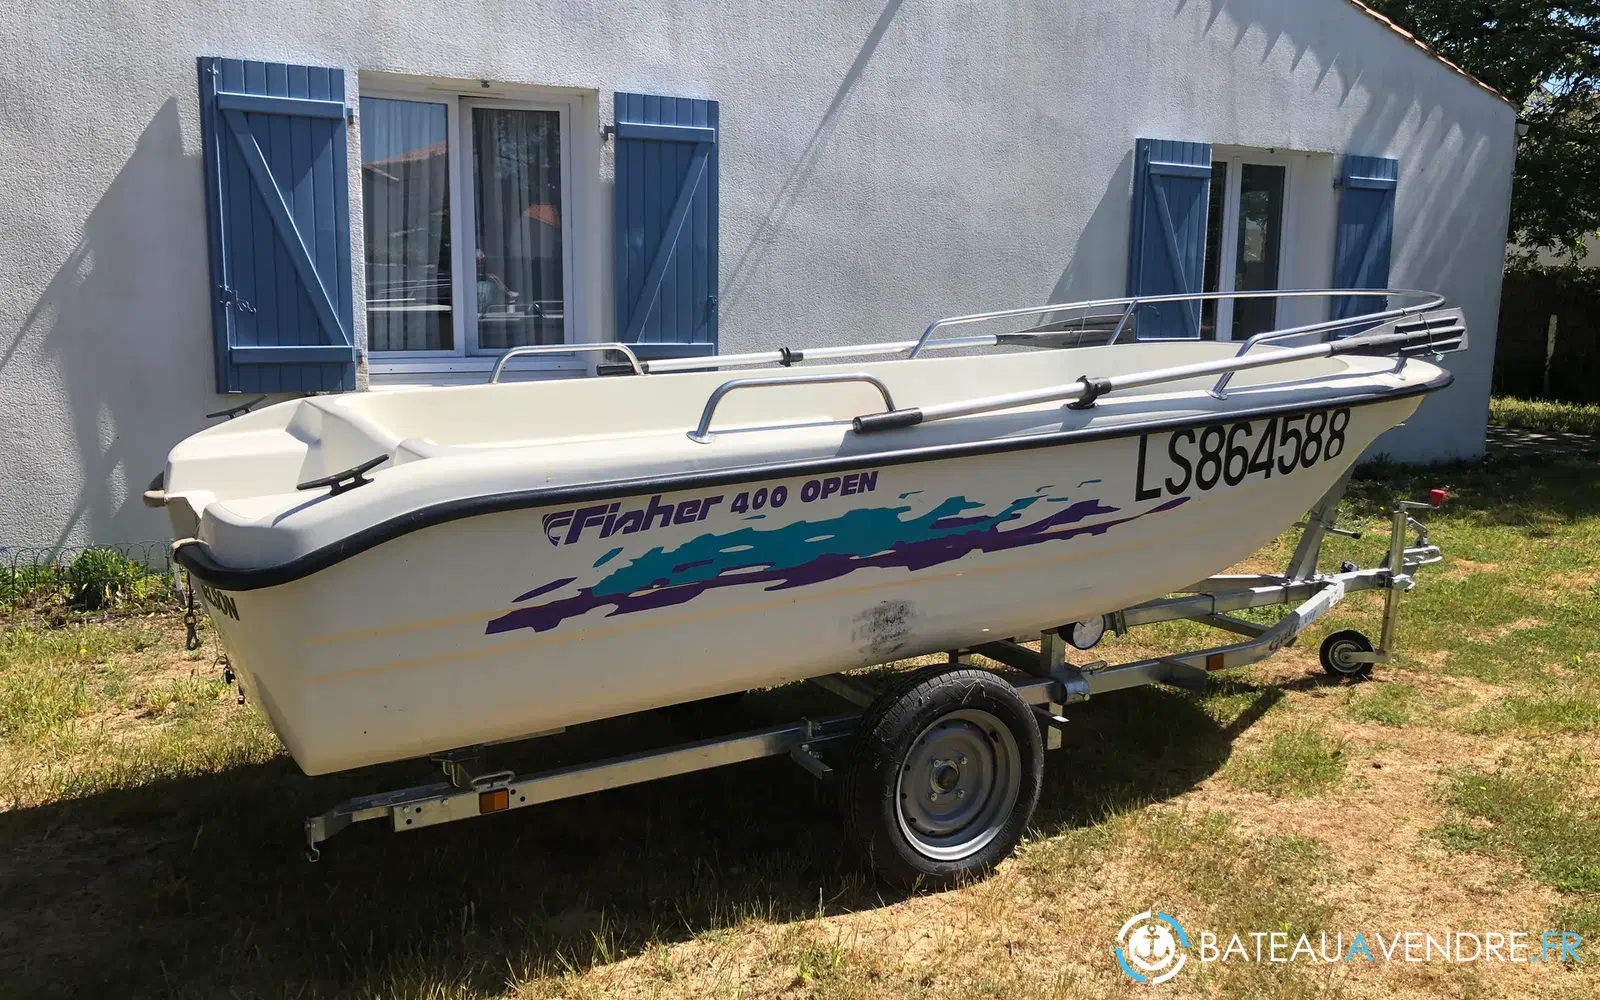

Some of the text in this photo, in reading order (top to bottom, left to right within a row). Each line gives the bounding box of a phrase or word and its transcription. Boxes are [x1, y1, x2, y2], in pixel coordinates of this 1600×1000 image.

[1135, 408, 1351, 502] LS864588
[730, 485, 788, 514] 400
[800, 470, 879, 503] OPEN
